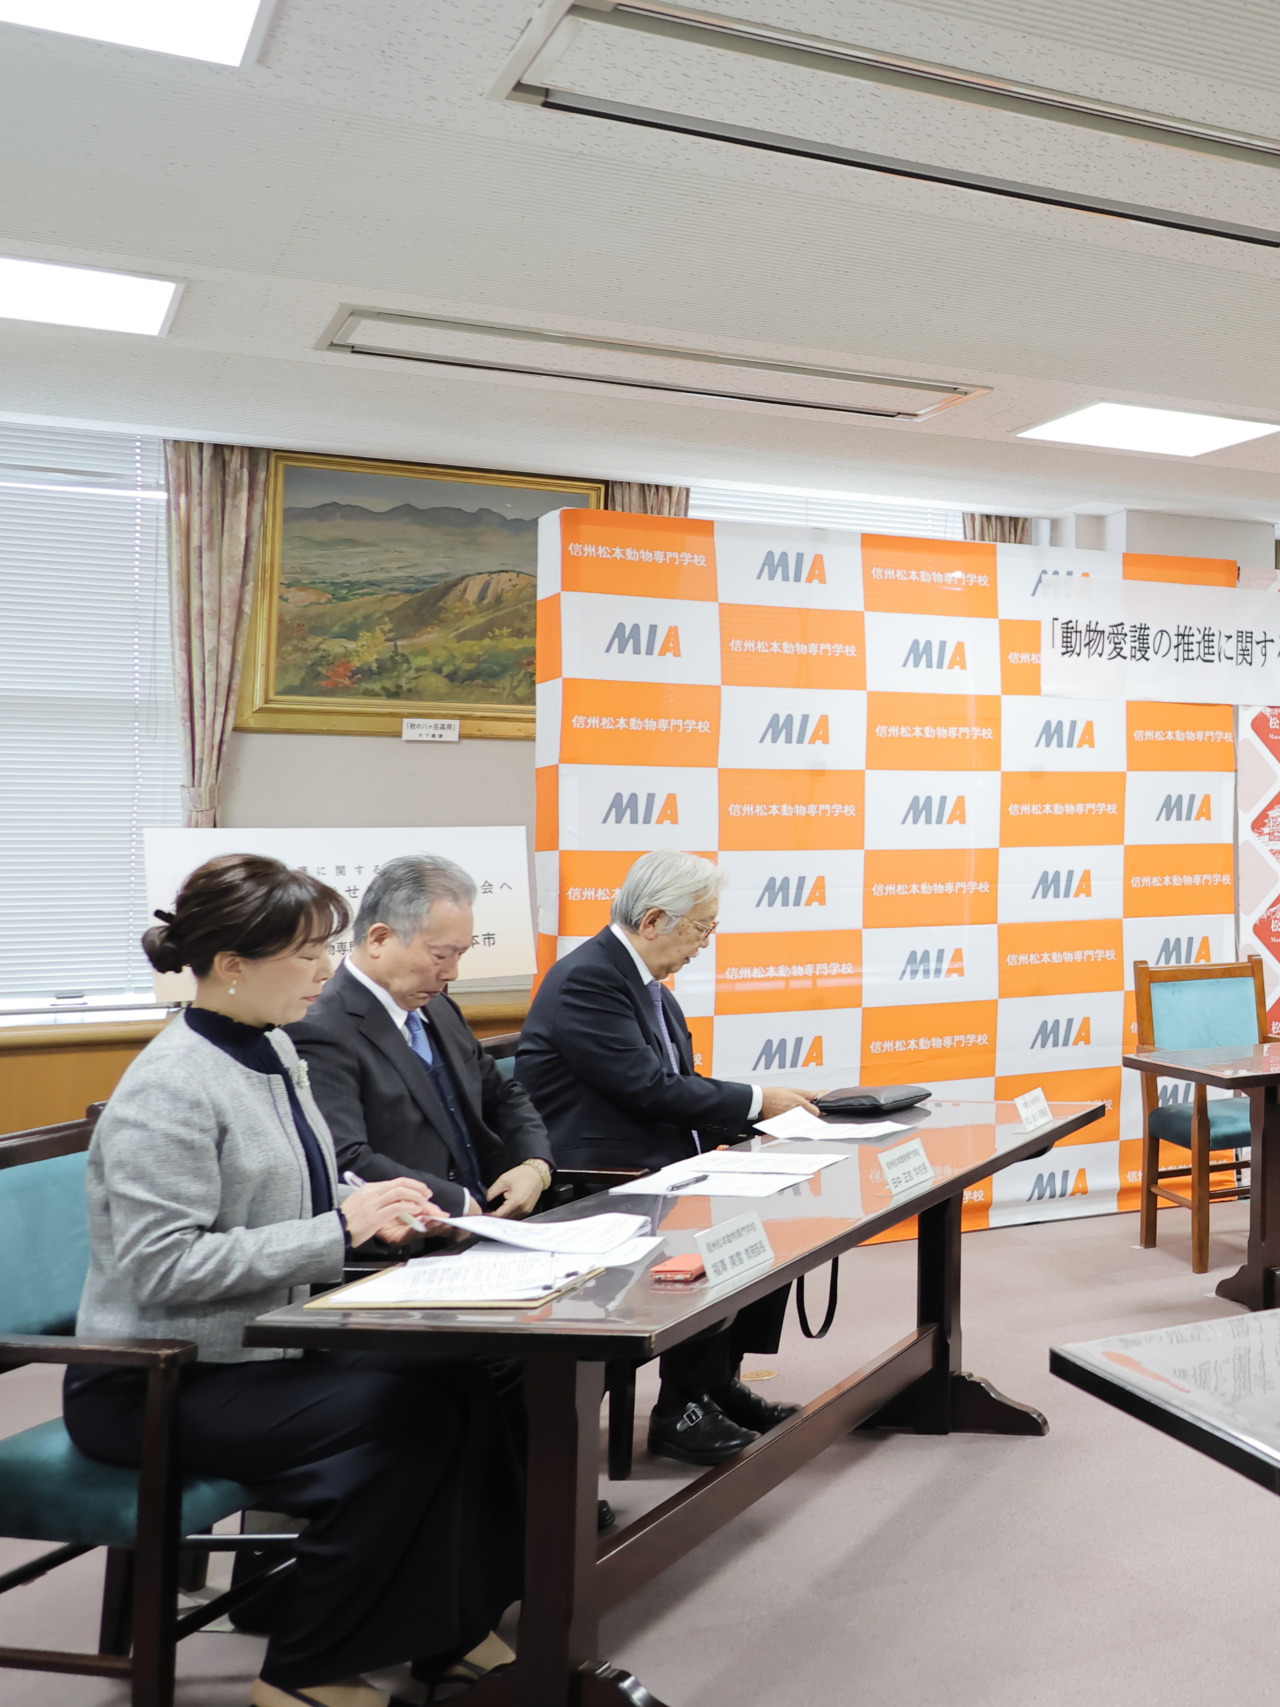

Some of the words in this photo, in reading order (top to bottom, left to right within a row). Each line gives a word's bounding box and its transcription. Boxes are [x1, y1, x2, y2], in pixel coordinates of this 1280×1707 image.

[568, 542, 707, 567] 信州松本動物専門学校
[756, 550, 827, 584] MIA
[871, 566, 989, 587] 信州松本動物専門学校
[605, 622, 681, 657] MIA
[729, 638, 857, 658] 信州松本動物専門学校
[902, 639, 967, 670] MIA
[571, 714, 711, 733] 信州松本動物専門学校
[759, 713, 830, 744] MIA
[875, 724, 993, 740] 信州松本動物専門学校
[1034, 720, 1095, 748] MIA
[1133, 729, 1233, 743] 信州松本動物専門学校
[602, 792, 679, 824] MIA
[728, 803, 856, 817] 信州松本動物専門学校
[901, 795, 966, 824] MIA
[1008, 803, 1117, 816] 信州松本動物専門学校
[1155, 793, 1212, 821] MIA
[755, 876, 826, 907] MIA
[872, 881, 990, 896] 信州松本動物専門学校
[1031, 869, 1092, 899] MIA
[1130, 873, 1231, 888] 信州松本動物専門学校
[899, 948, 965, 980] MIA
[1006, 948, 1116, 966] 信州松本動物専門学校
[1155, 936, 1211, 965] MIA
[725, 961, 854, 980] 信州松本動物専門学校
[869, 1033, 989, 1053] 信州松本動物専門学校
[1029, 1016, 1091, 1049] MIA
[752, 1035, 824, 1071] MIA
[1158, 1083, 1192, 1105] MI
[1027, 1168, 1089, 1202] MIA
